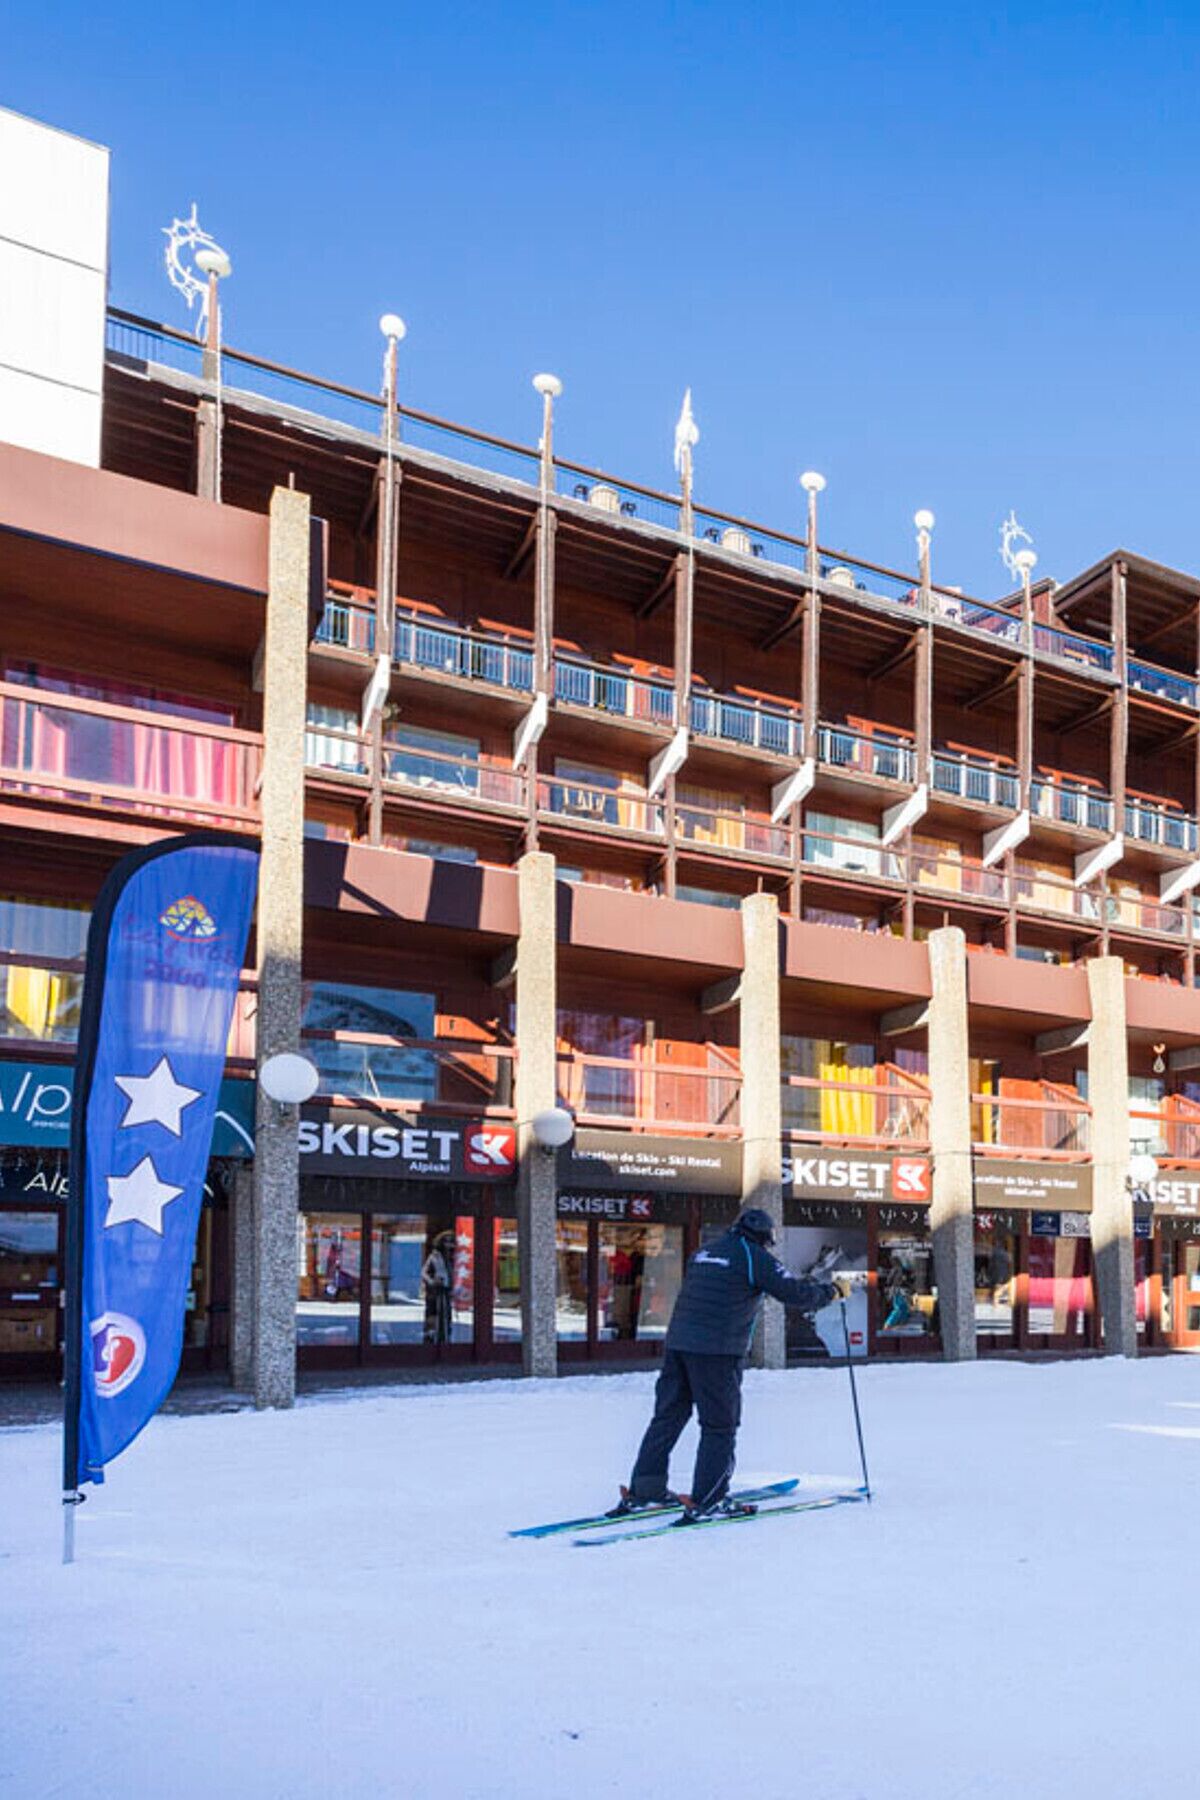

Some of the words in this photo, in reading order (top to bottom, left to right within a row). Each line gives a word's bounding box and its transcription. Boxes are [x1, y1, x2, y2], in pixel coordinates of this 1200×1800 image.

[0, 1072, 71, 1121] lp
[298, 1122, 459, 1160] SKISET
[620, 1152, 634, 1163] de
[781, 1157, 890, 1189] SKISET
[558, 1196, 627, 1213] SKISET
